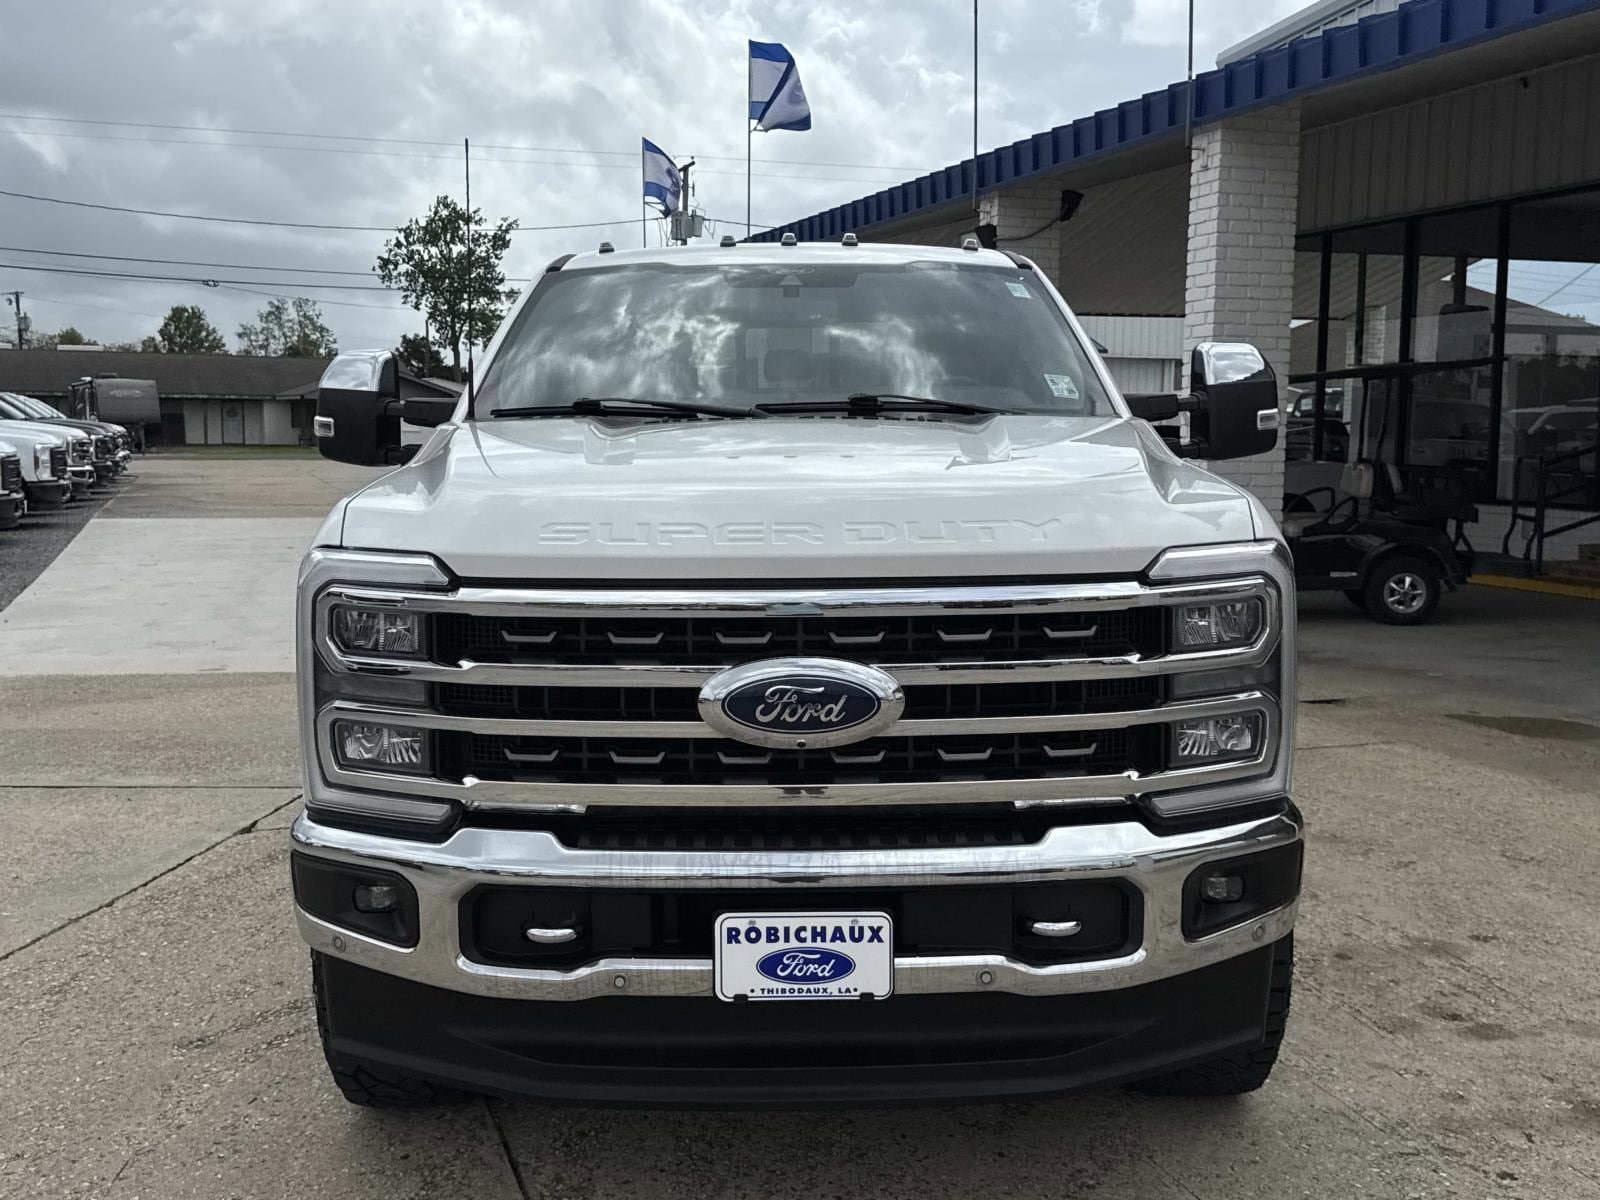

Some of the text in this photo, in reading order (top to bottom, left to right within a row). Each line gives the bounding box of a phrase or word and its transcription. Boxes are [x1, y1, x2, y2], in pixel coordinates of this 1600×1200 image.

[538, 518, 1061, 545] SUPER DUTY
[755, 685, 848, 722] Ford
[726, 925, 885, 945] ROBICHAUX
[776, 952, 836, 977] Ford
[760, 986, 851, 996] THIBODAUX, LA
